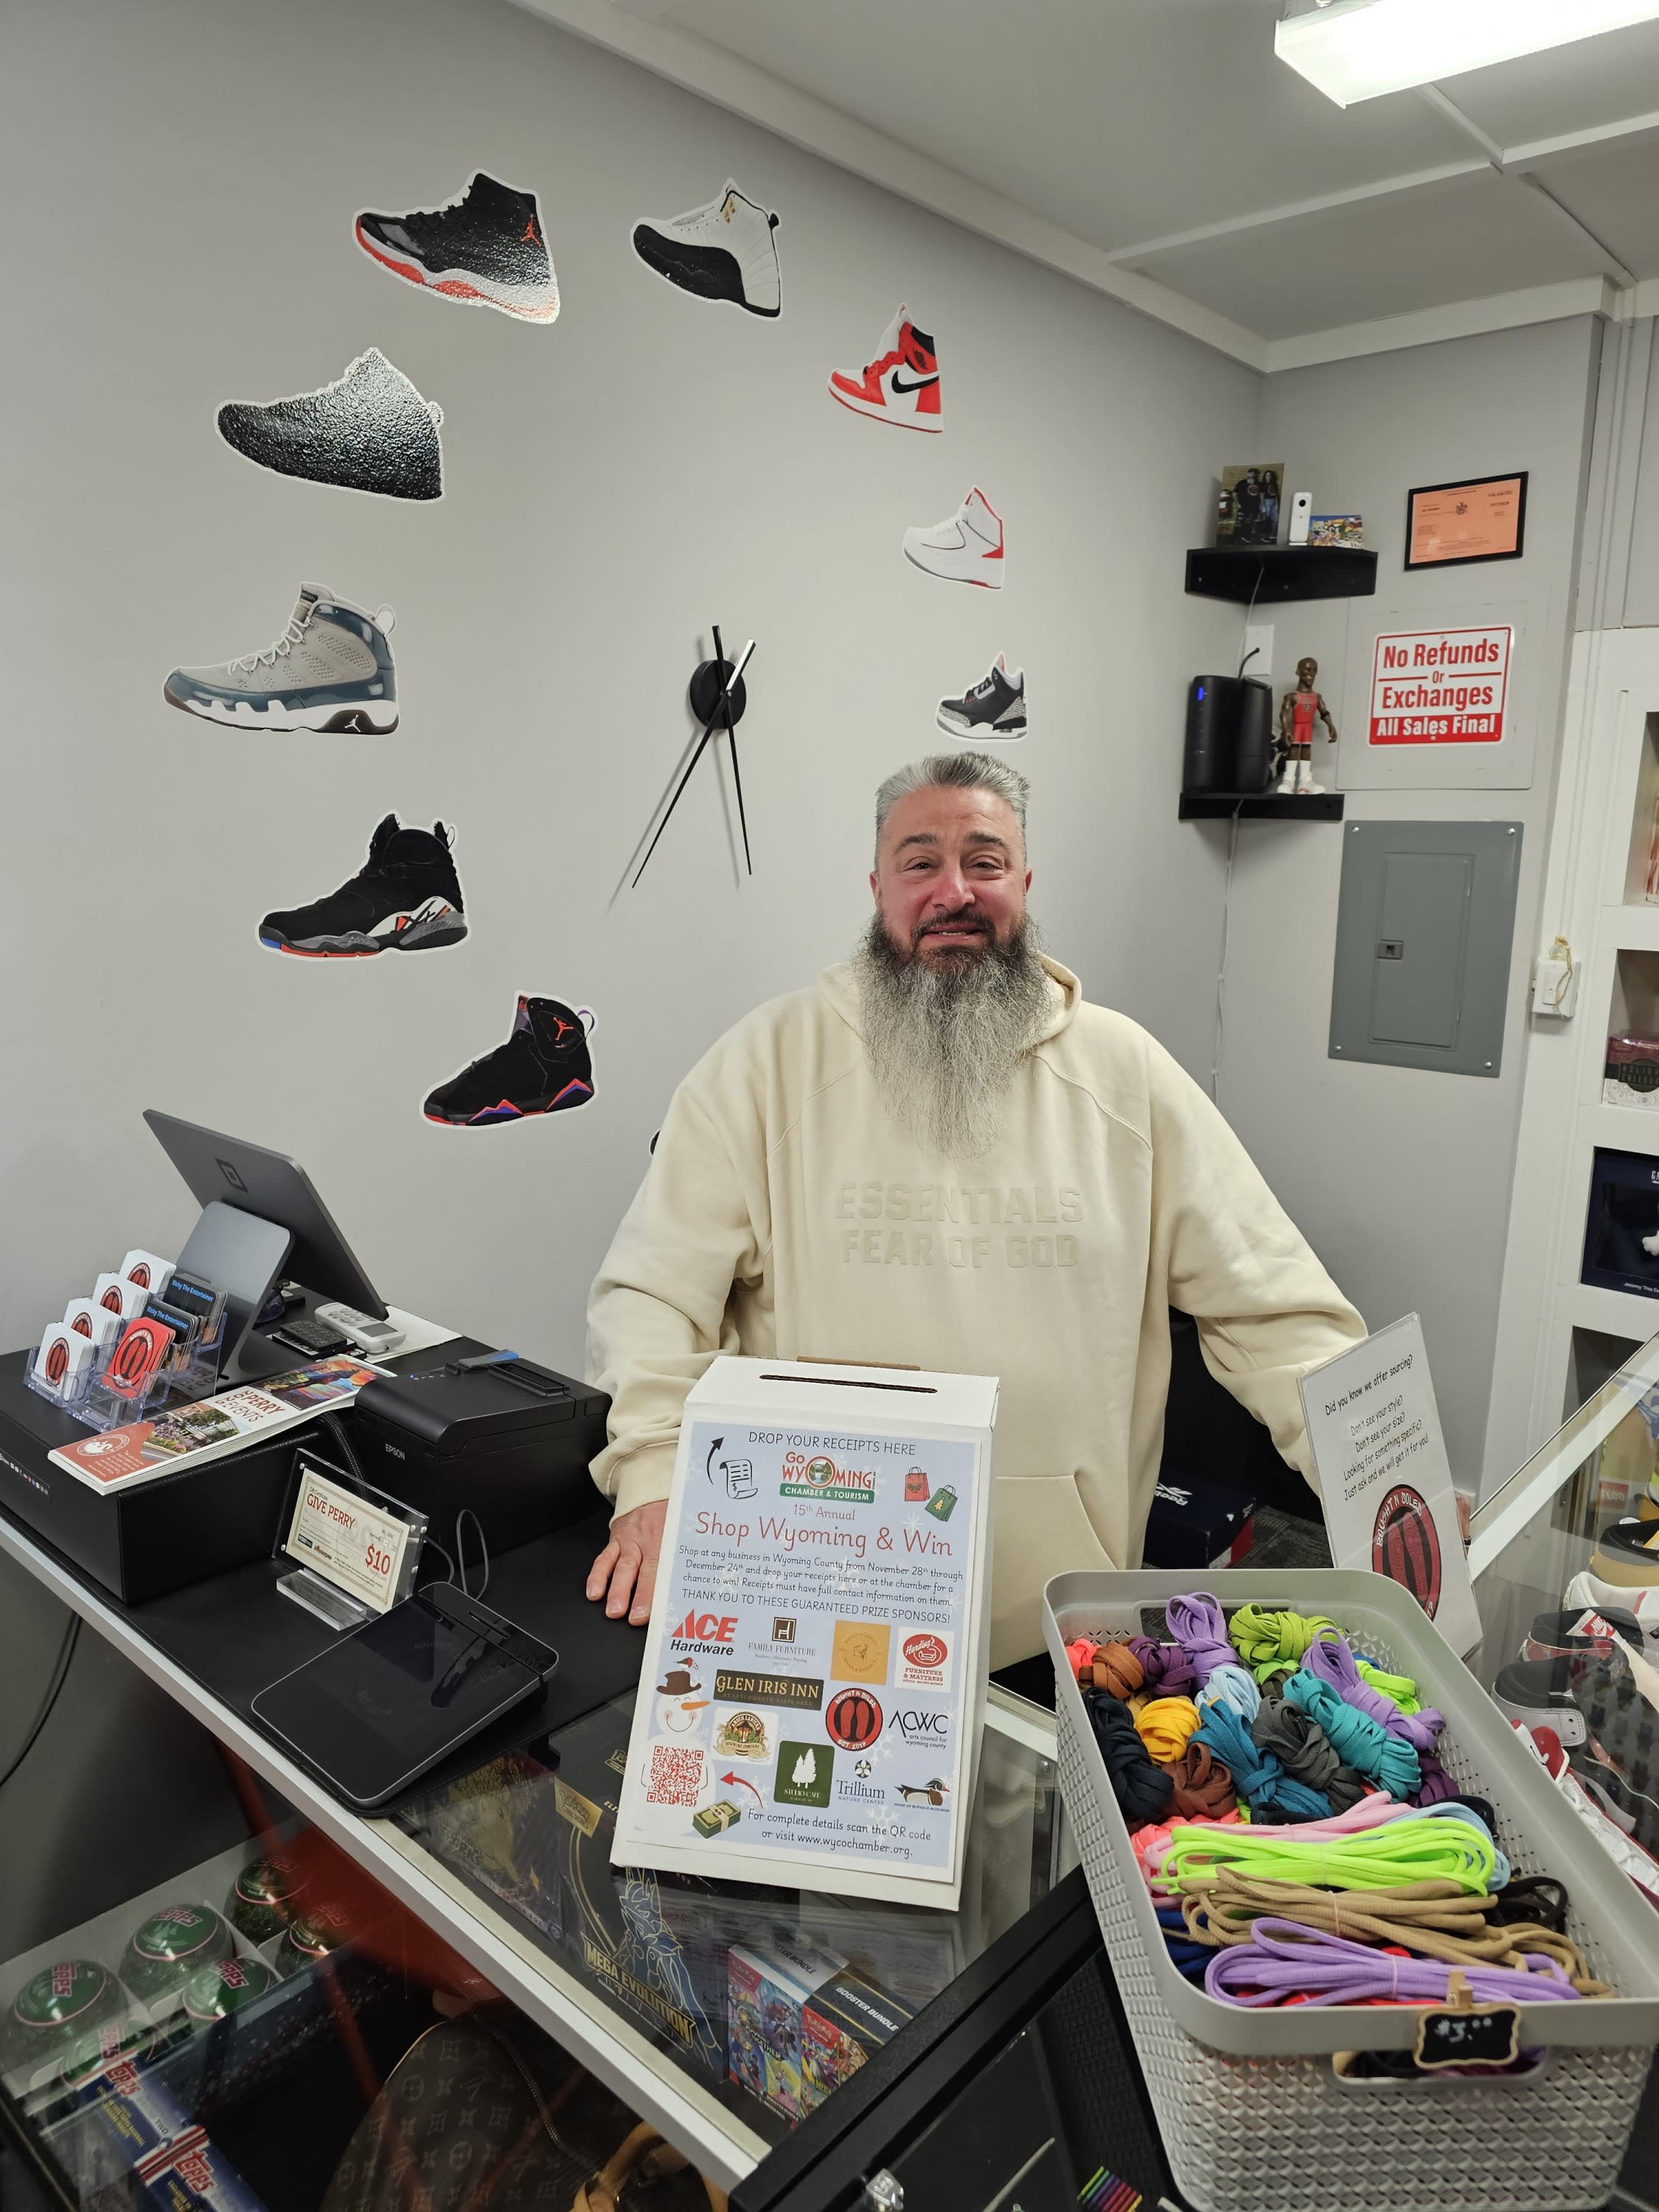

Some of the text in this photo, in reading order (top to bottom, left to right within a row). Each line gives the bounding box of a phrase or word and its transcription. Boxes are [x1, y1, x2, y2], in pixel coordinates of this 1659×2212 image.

[1383, 639, 1499, 669] No Refunds
[1432, 670, 1444, 684] Or
[1382, 684, 1493, 712] Exchanges
[1377, 714, 1495, 737] All Sales Final
[835, 1182, 1084, 1224] ESSENTIALS
[843, 1229, 1079, 1268] FEAR OF GOD
[172, 1279, 214, 1303] Ricky The Entertainer
[157, 1310, 166, 1319] The
[1325, 1354, 1413, 1416] Did you know we offer sourcing?
[220, 1402, 263, 1422] EVENTS
[241, 1394, 285, 1414] PERRY
[1351, 1395, 1403, 1436] Don't see your style?
[749, 1431, 916, 1455] DROP YOUR RECEIPTS HERE
[1355, 1412, 1405, 1453] Don't see your size?
[385, 1443, 406, 1461] EPSON
[1343, 1419, 1422, 1481] Looking for something specific?
[782, 1455, 872, 1489] WYOMING
[1344, 1484, 1357, 1501] Just
[1357, 1476, 1368, 1491] ask
[1368, 1469, 1378, 1484] and
[1377, 1466, 1386, 1477] we
[1385, 1456, 1395, 1470] will
[1395, 1450, 1405, 1467] get
[1404, 1447, 1410, 1458] it
[1410, 1441, 1419, 1454] for
[785, 1486, 824, 1497] CHAMBER
[835, 1491, 869, 1500] TOURISM
[1155, 1490, 1188, 1506] Reeb
[307, 1493, 355, 1530] GIVE PERRY
[793, 1503, 856, 1521] 15th Annual
[1377, 1497, 1394, 1547] BOUGHT
[695, 1512, 953, 1558] Shop Wyoming & Win
[365, 1543, 391, 1575] $10
[678, 1545, 963, 1582] Shop at any business in Wyoming County from November 28th through
[683, 1573, 711, 1584] chance
[723, 1573, 740, 1586] win!
[742, 1578, 773, 1591] Receipts
[776, 1582, 796, 1591] must
[798, 1582, 816, 1593] have
[818, 1585, 832, 1596] full
[834, 1587, 863, 1598] contact
[866, 1590, 914, 1603] information
[917, 1596, 928, 1604] on
[930, 1596, 953, 1607] them.
[686, 1559, 726, 1571] December
[727, 1562, 744, 1572] 24th
[745, 1566, 760, 1574] and
[763, 1568, 782, 1579] drop
[784, 1571, 803, 1581] your
[804, 1572, 836, 1583] receipts
[838, 1573, 857, 1584] here
[870, 1577, 878, 1585] at
[880, 1578, 894, 1587] the
[895, 1579, 932, 1590] chamber
[933, 1582, 947, 1595] for
[682, 1588, 950, 1624] THANK YOU TO THESE GUARANTEED PRIZE SPONSORS!
[672, 1608, 739, 1643] ACE
[670, 1639, 734, 1656] Hardware
[748, 1642, 816, 1657] FAMILY FURNITURE
[905, 1636, 936, 1657] Harding's
[905, 1667, 943, 1676] FURNITURE
[716, 1676, 819, 1699] GLEN IRIS INN
[888, 1710, 948, 1738] ACWC
[905, 1740, 928, 1748] wyoming
[837, 1779, 885, 1799] Trillium
[748, 1808, 931, 1841] For complete details scan the QR code
[762, 1829, 913, 1860] or visit www.wycochamber.org.
[790, 1955, 817, 1975] BUNDLE
[586, 1941, 690, 2043] MEGA EVOLUTION
[836, 1986, 900, 2033] BOOSTER BUNDLE
[104, 2060, 142, 2098] Topps
[173, 2149, 218, 2194] Topps
